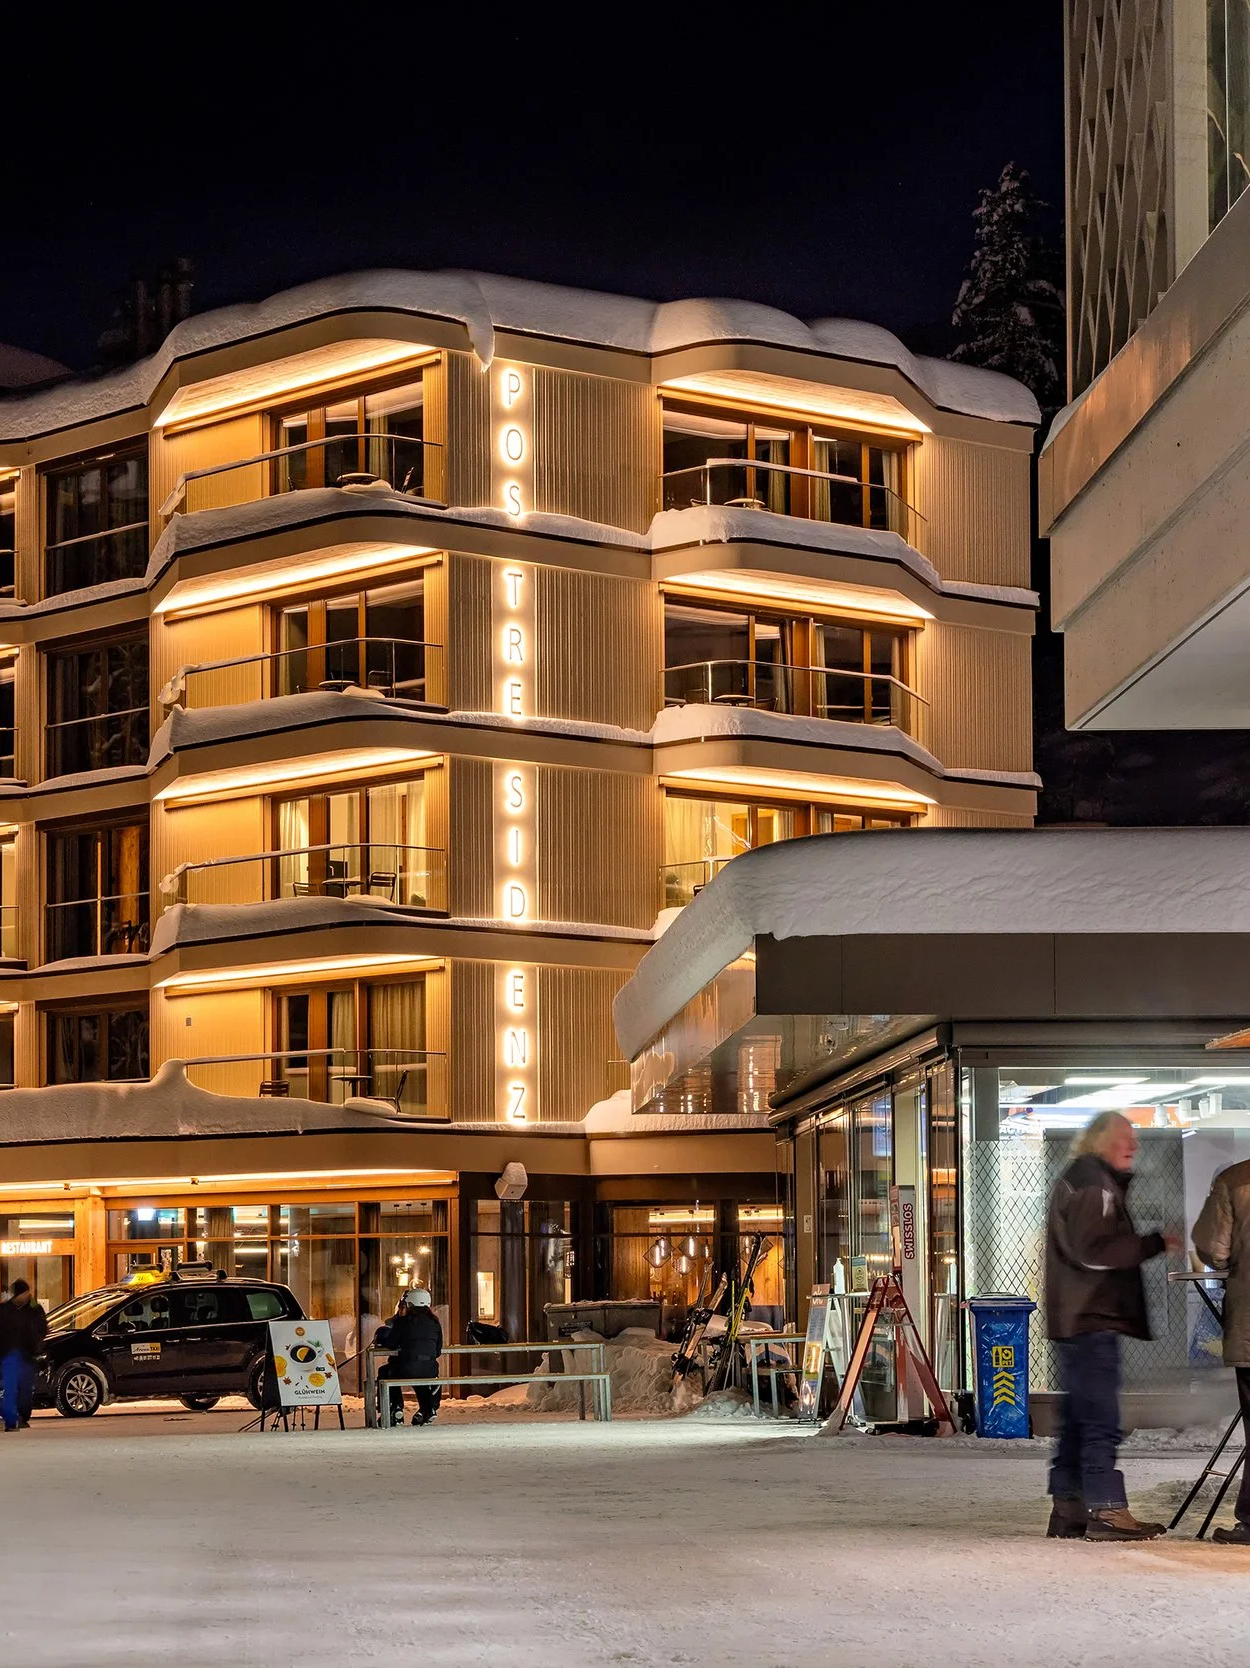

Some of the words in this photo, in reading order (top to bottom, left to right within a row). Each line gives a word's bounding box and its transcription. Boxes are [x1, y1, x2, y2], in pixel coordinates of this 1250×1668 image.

[903, 1203, 915, 1260] SWISSLOS
[1, 1240, 53, 1255] RESTAURANT
[294, 1388, 326, 1396] GLÜHWEIN
